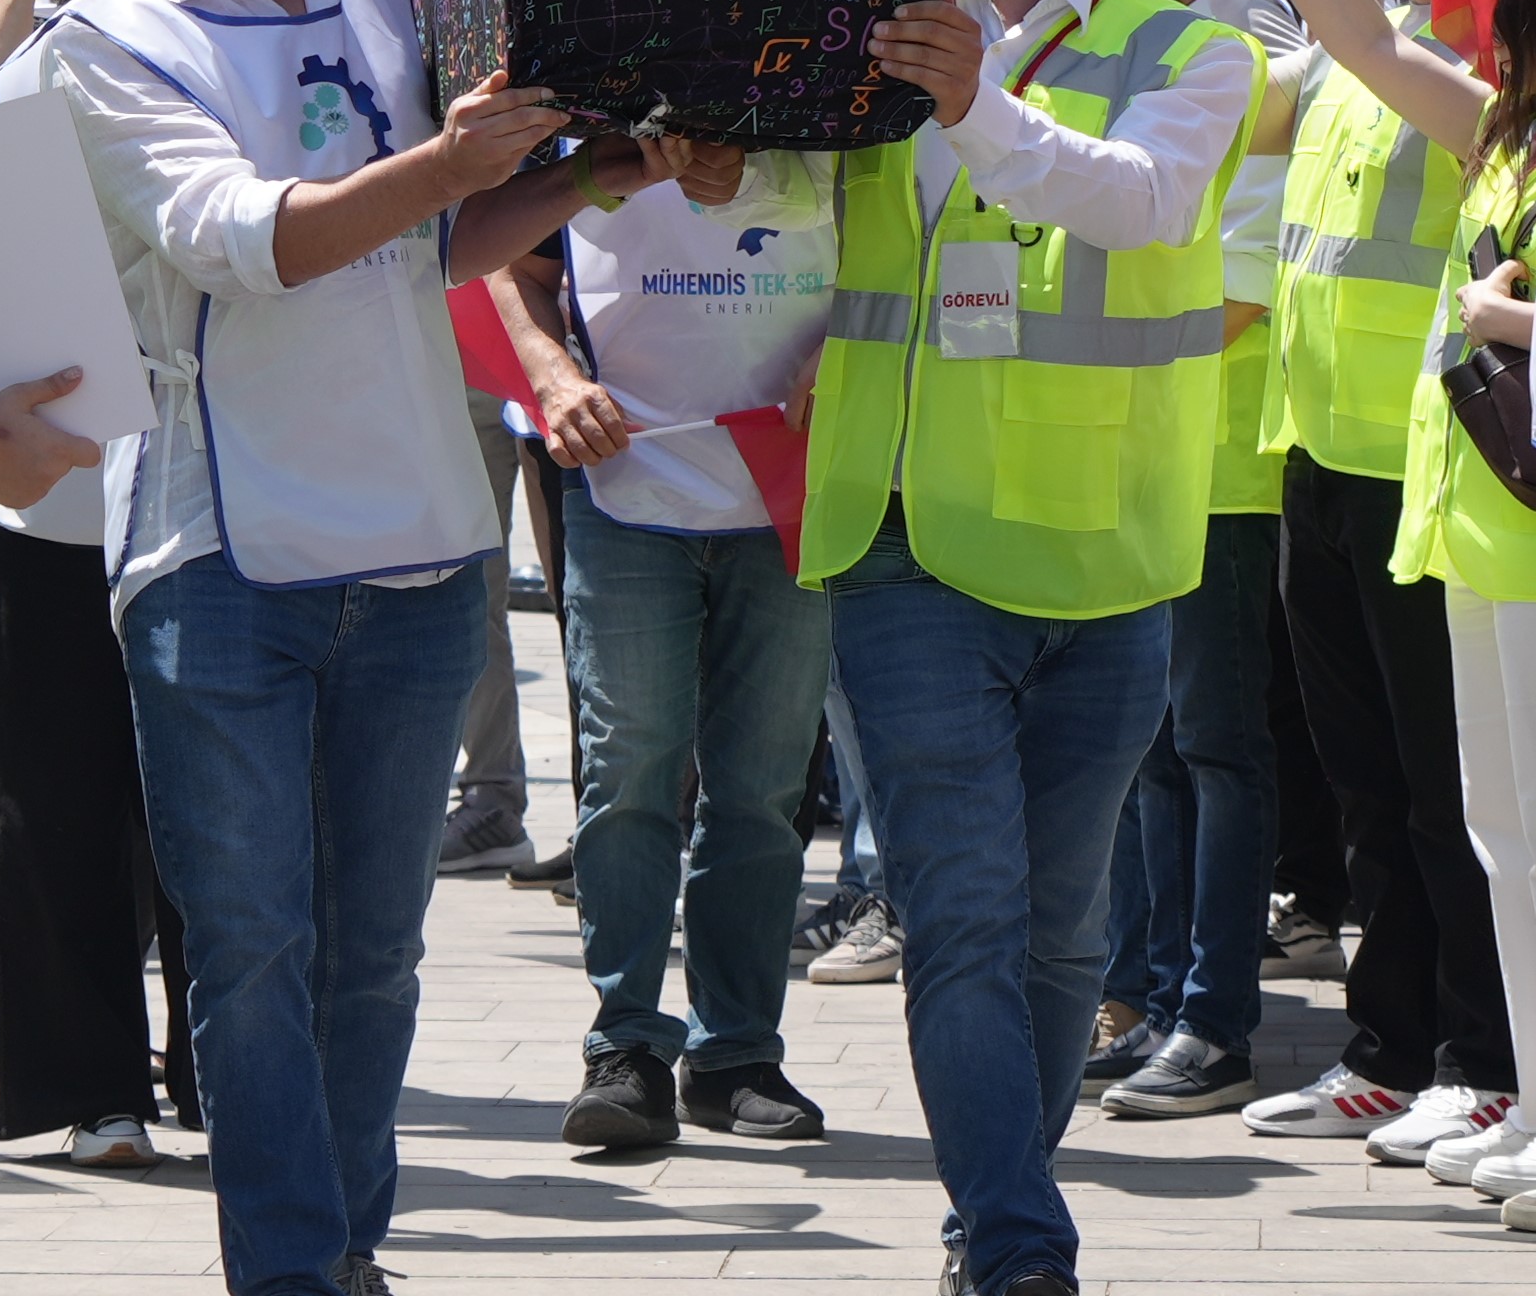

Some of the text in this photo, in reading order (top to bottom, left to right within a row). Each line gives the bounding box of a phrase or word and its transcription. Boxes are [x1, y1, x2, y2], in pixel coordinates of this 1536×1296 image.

[642, 268, 824, 296] MÜHENDİS TEK-SEN
[705, 301, 774, 315] ENERJİ
[942, 288, 1010, 309] GÖREVLİ
